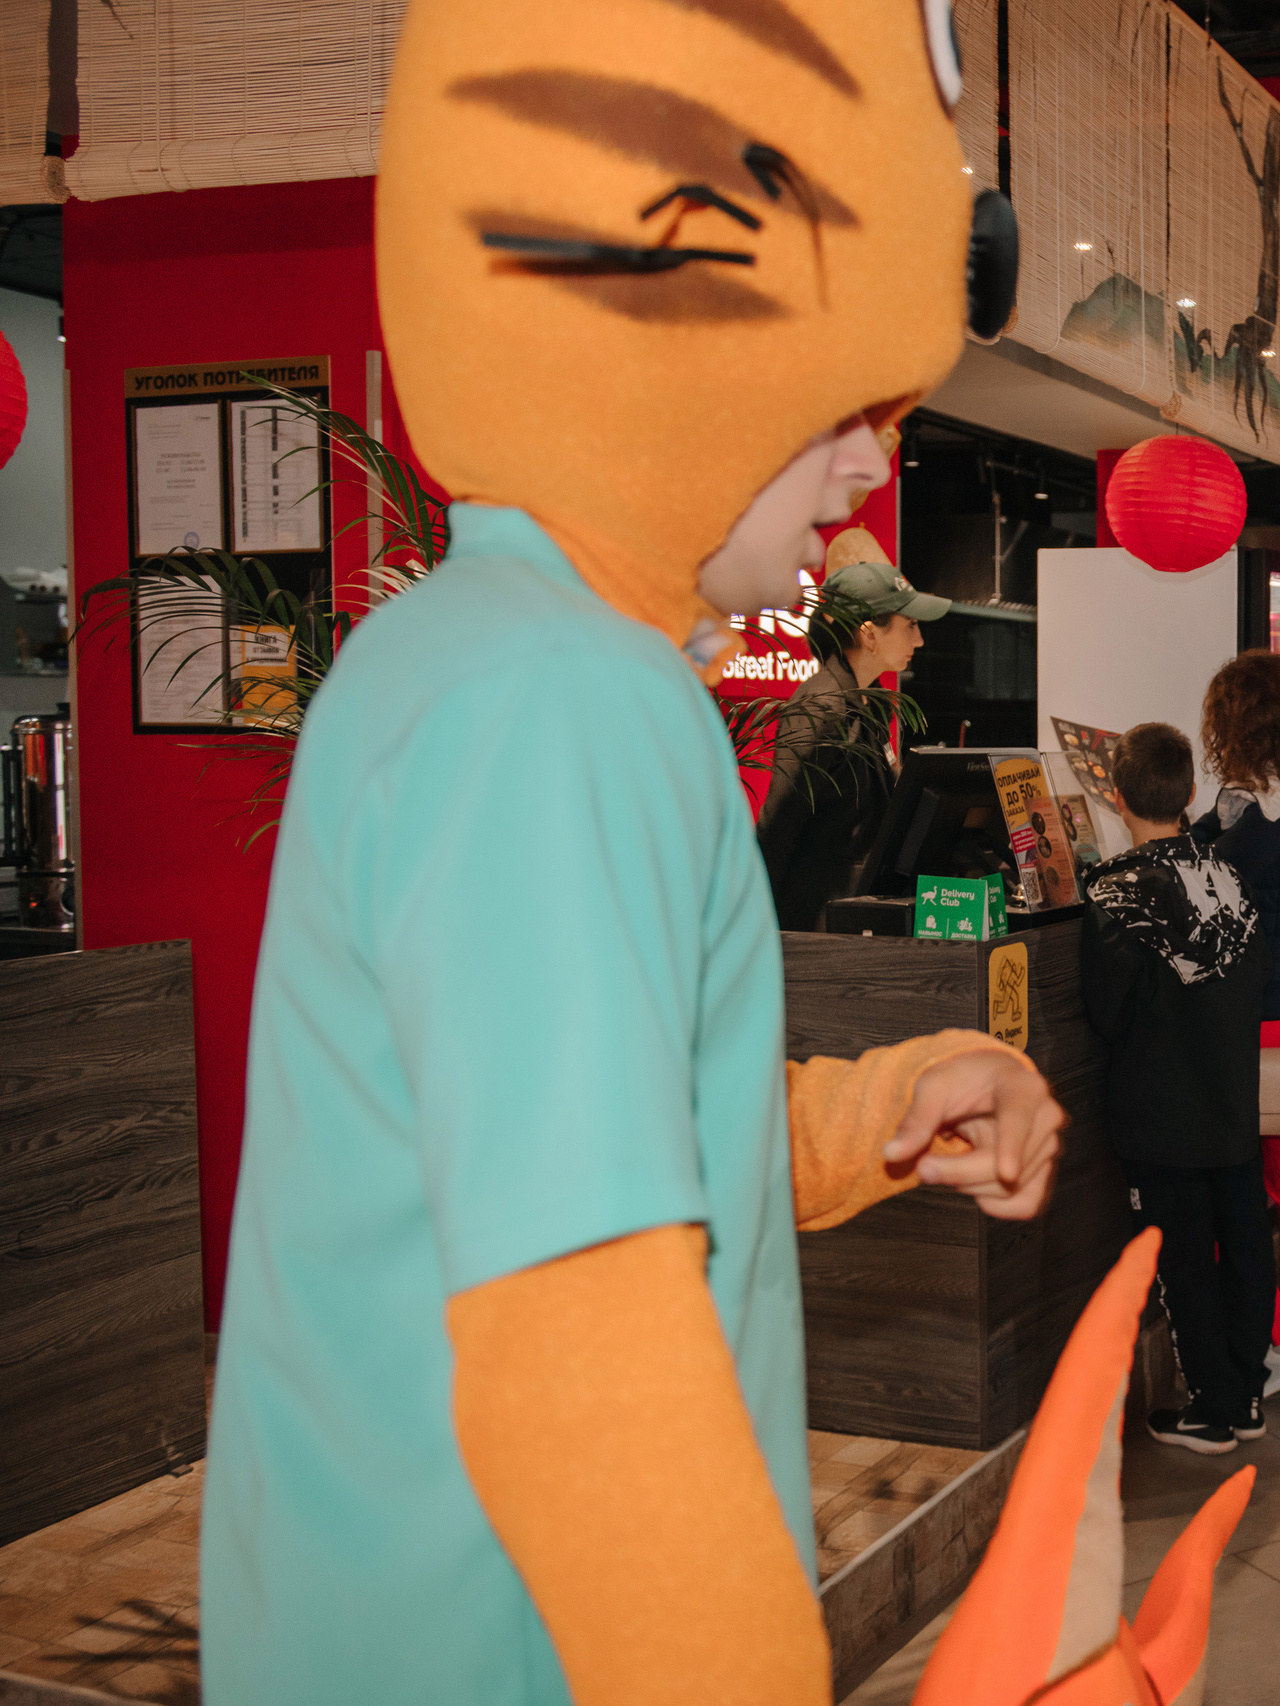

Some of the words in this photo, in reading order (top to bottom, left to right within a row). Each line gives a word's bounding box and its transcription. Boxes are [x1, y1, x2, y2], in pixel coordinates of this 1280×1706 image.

[135, 373, 198, 391] УГОЛОК
[203, 365, 320, 387] ПОТРЕБИТЕЛЯ
[722, 651, 775, 680] Street
[997, 765, 1041, 788] ОПЛАЧИВАЙ
[1006, 790, 1020, 808] ДО
[1019, 782, 1042, 800] 50%
[1005, 806, 1025, 817] ЗАКАЗА
[940, 897, 960, 907] Club
[941, 888, 975, 901] Delivery
